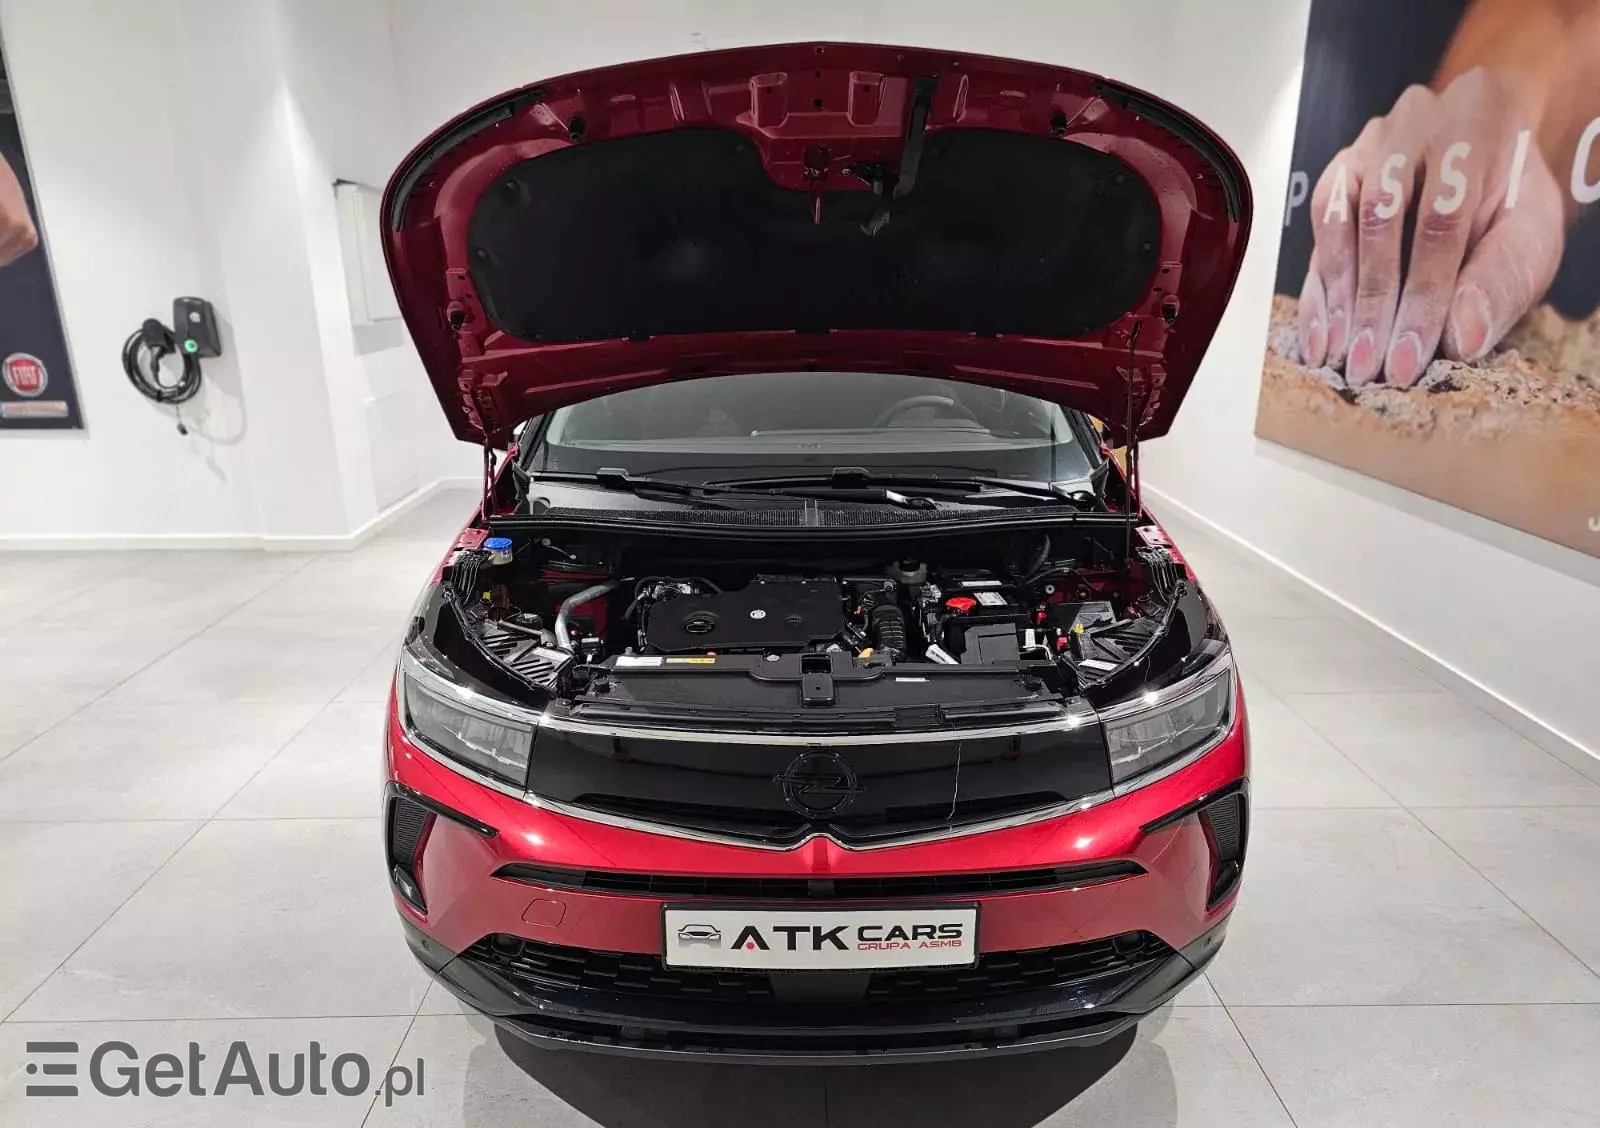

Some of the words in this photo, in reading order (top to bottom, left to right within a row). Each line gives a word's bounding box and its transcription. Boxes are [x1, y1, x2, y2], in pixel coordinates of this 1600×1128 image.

[12, 366, 38, 385] FIAT
[730, 925, 849, 950] ATK
[857, 923, 963, 941] CARS
[857, 941, 911, 951] GRUPA
[918, 939, 962, 949] ASMB
